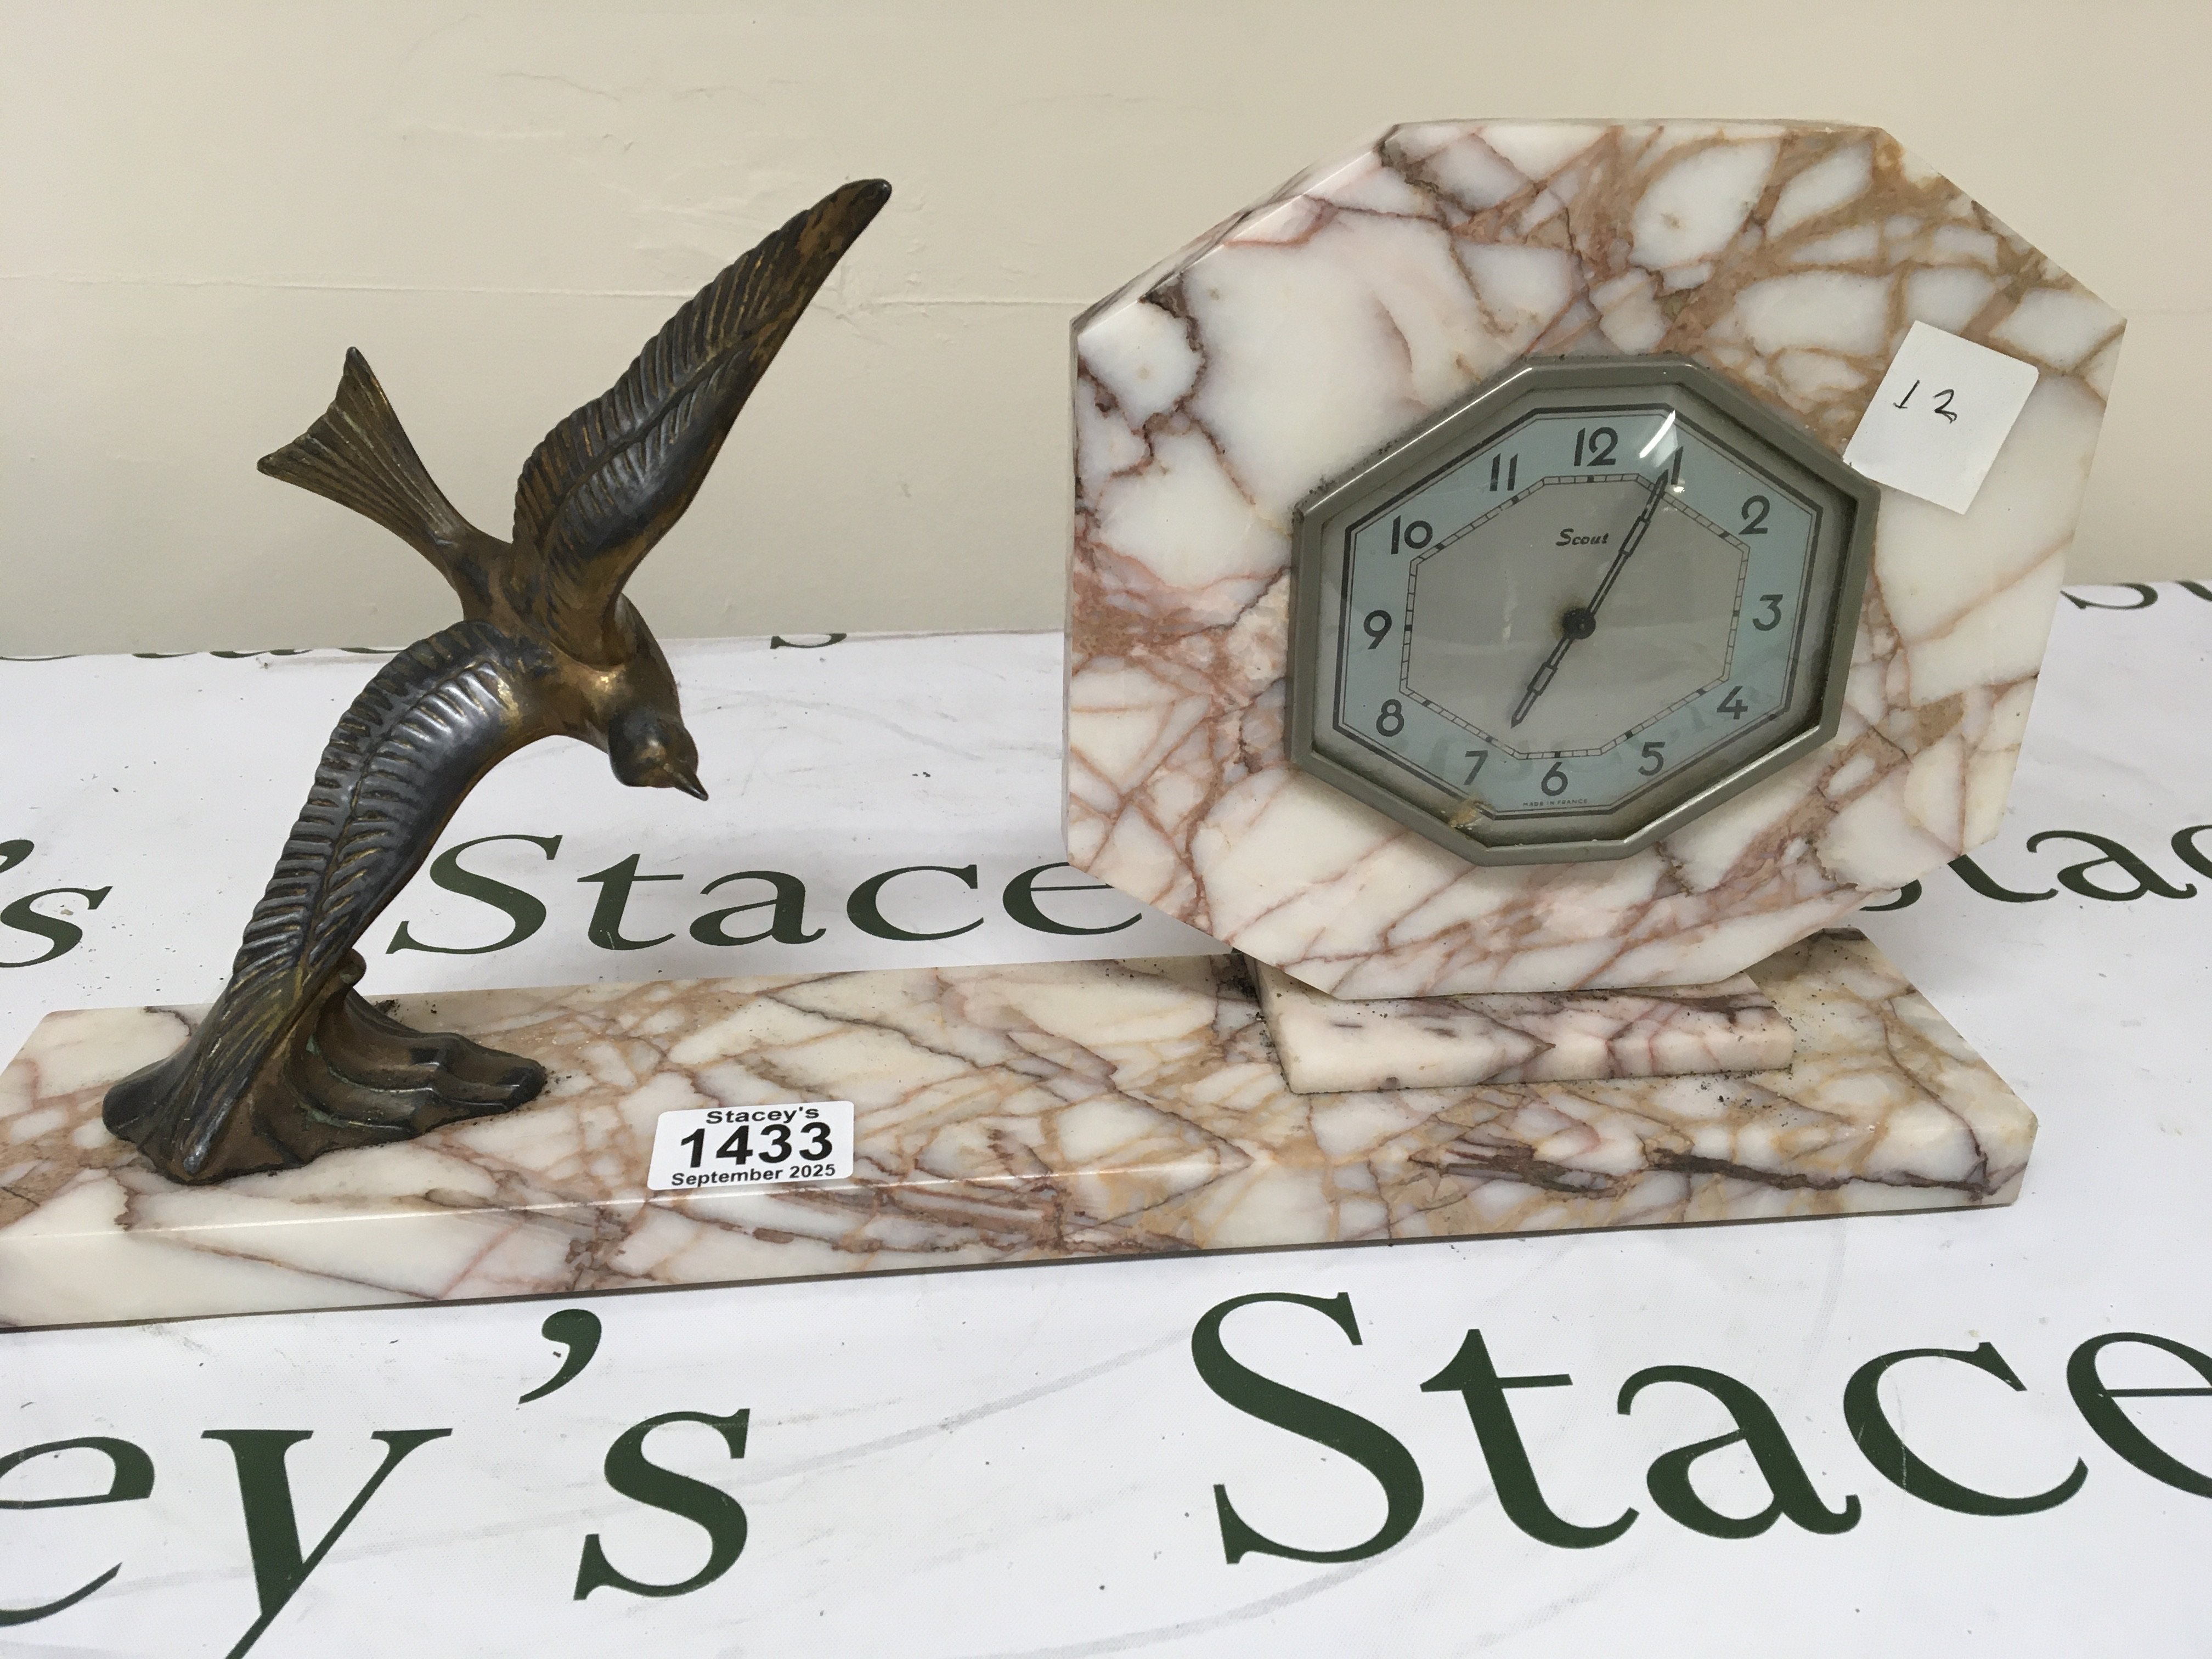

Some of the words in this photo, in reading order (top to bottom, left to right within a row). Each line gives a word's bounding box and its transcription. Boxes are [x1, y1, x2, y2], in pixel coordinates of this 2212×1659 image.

[1573, 426, 1619, 467] 12
[1488, 453, 1519, 492] 11
[1671, 446, 1684, 486] 1
[1738, 494, 1771, 535] 2
[1390, 514, 1434, 555] 10
[1555, 528, 1609, 546] Scout
[1363, 609, 1392, 650] 9
[1752, 594, 1784, 631] 3
[1375, 698, 1405, 737] 8
[1716, 685, 1748, 720] 4
[1464, 749, 1489, 786] 7
[1637, 741, 1666, 776] 5
[1541, 761, 1569, 797] 6
[706, 1106, 819, 1124] Stacey's
[680, 1121, 833, 1169] 1433
[671, 1169, 783, 1187] September
[789, 1164, 836, 1179] 2025
